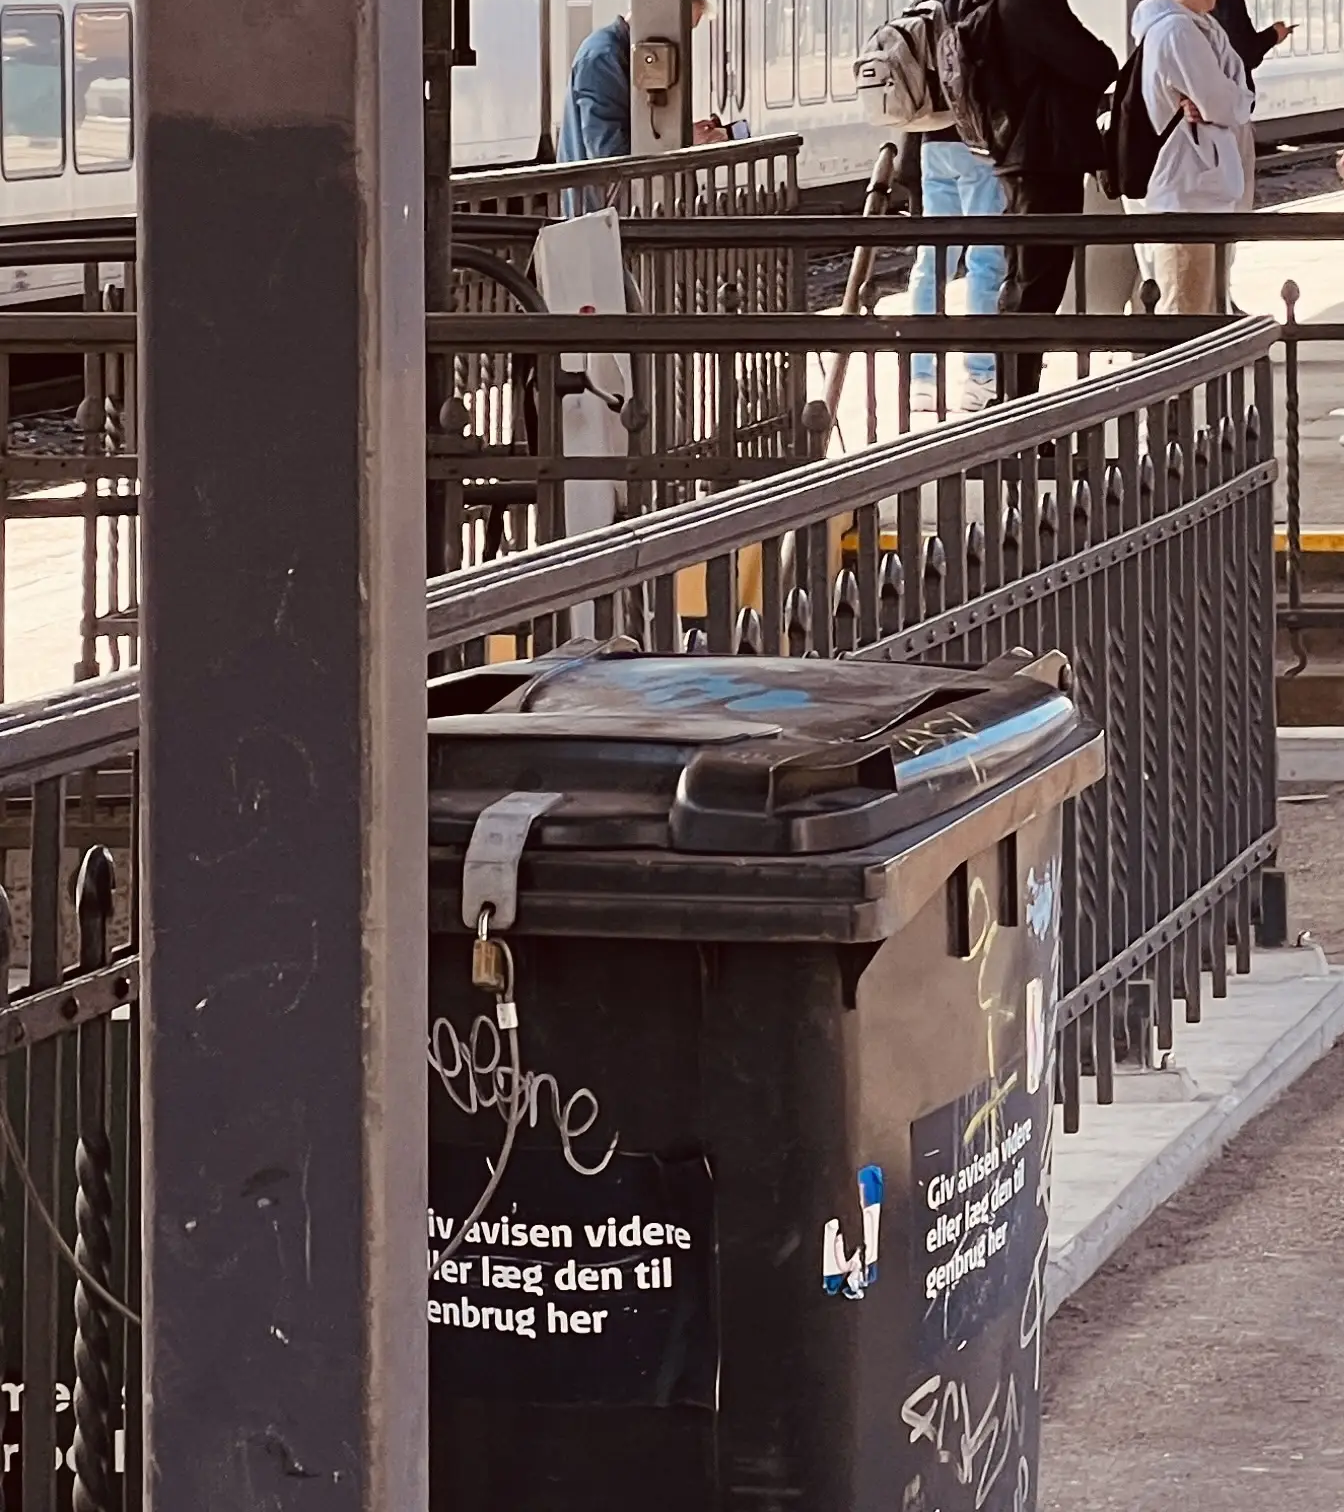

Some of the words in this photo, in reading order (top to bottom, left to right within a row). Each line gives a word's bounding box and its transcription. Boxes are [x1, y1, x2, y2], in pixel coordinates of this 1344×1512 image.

[927, 1173, 955, 1210] Giv
[957, 1146, 999, 1194] avisen
[1001, 1118, 1032, 1163] videre
[428, 1208, 454, 1239] iv
[464, 1215, 573, 1248] avisen
[584, 1215, 692, 1250] videre
[925, 1213, 963, 1253] eller
[964, 1199, 992, 1233] læg
[991, 1177, 1013, 1213] den
[482, 1256, 544, 1296] læg
[555, 1259, 623, 1291] den
[634, 1257, 673, 1289] til
[925, 1233, 987, 1300] genbrug
[988, 1220, 1009, 1257] her
[428, 1296, 536, 1339] enbrug
[547, 1302, 609, 1335] her
